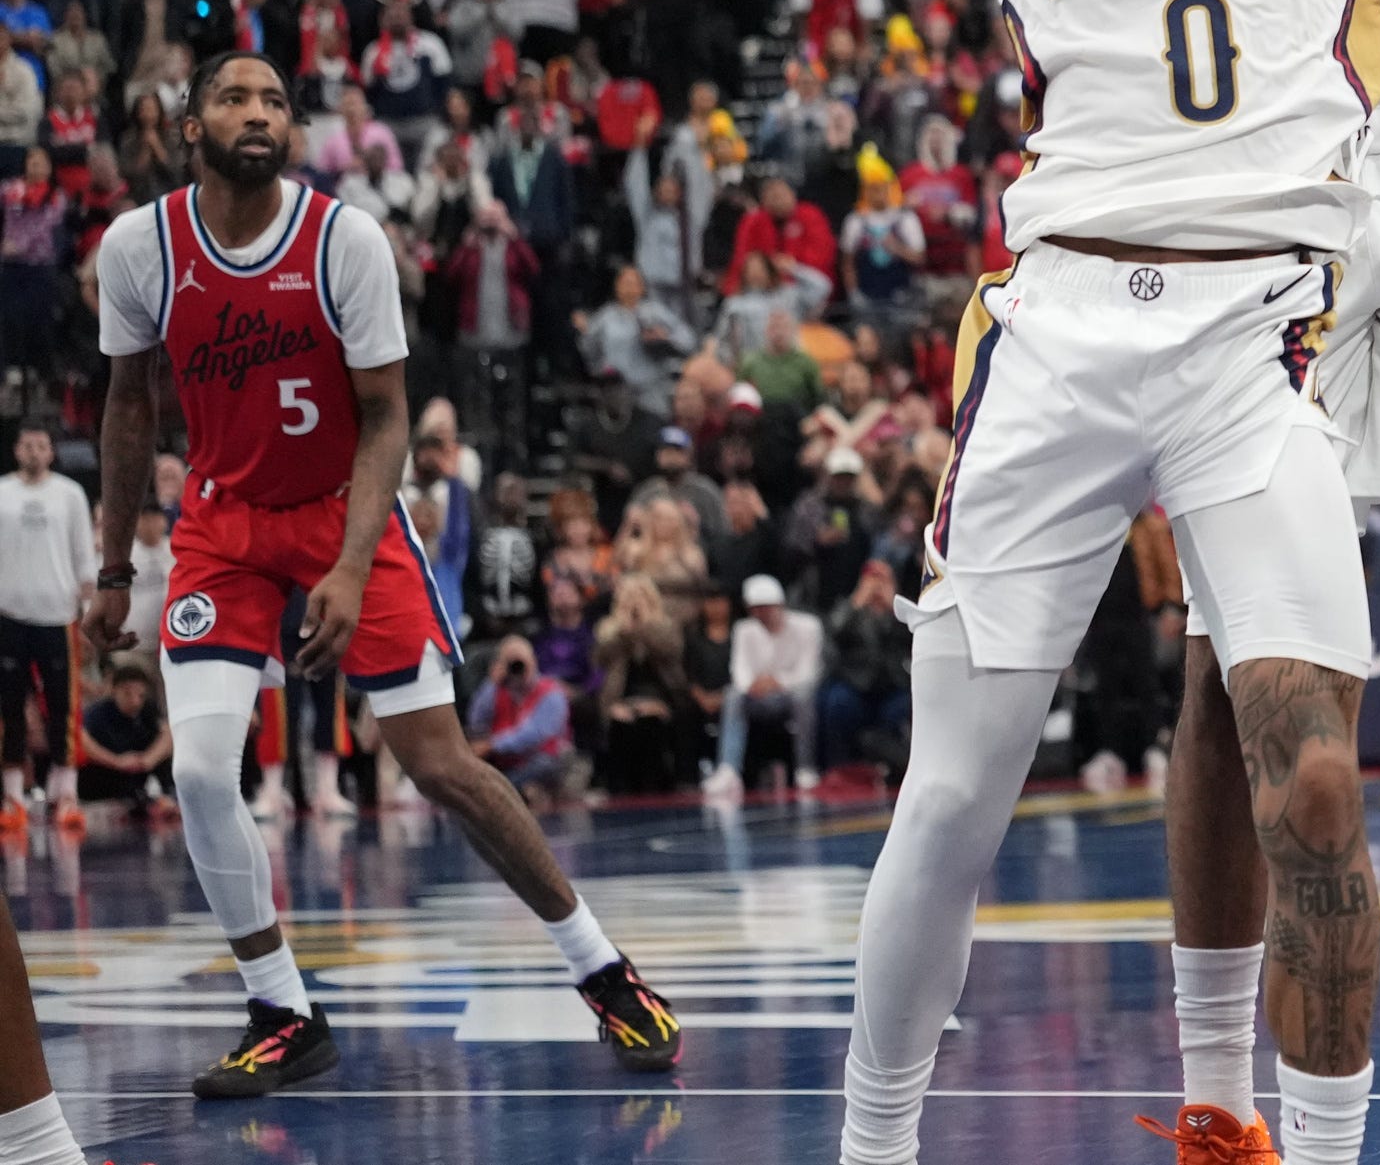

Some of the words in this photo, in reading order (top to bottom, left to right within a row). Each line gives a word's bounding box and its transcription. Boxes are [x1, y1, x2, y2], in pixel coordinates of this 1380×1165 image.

[269, 280, 312, 291] RWANDA
[277, 272, 303, 282] VISIT
[214, 300, 271, 346] Los
[182, 321, 320, 391] Angeles
[277, 377, 320, 436] 5
